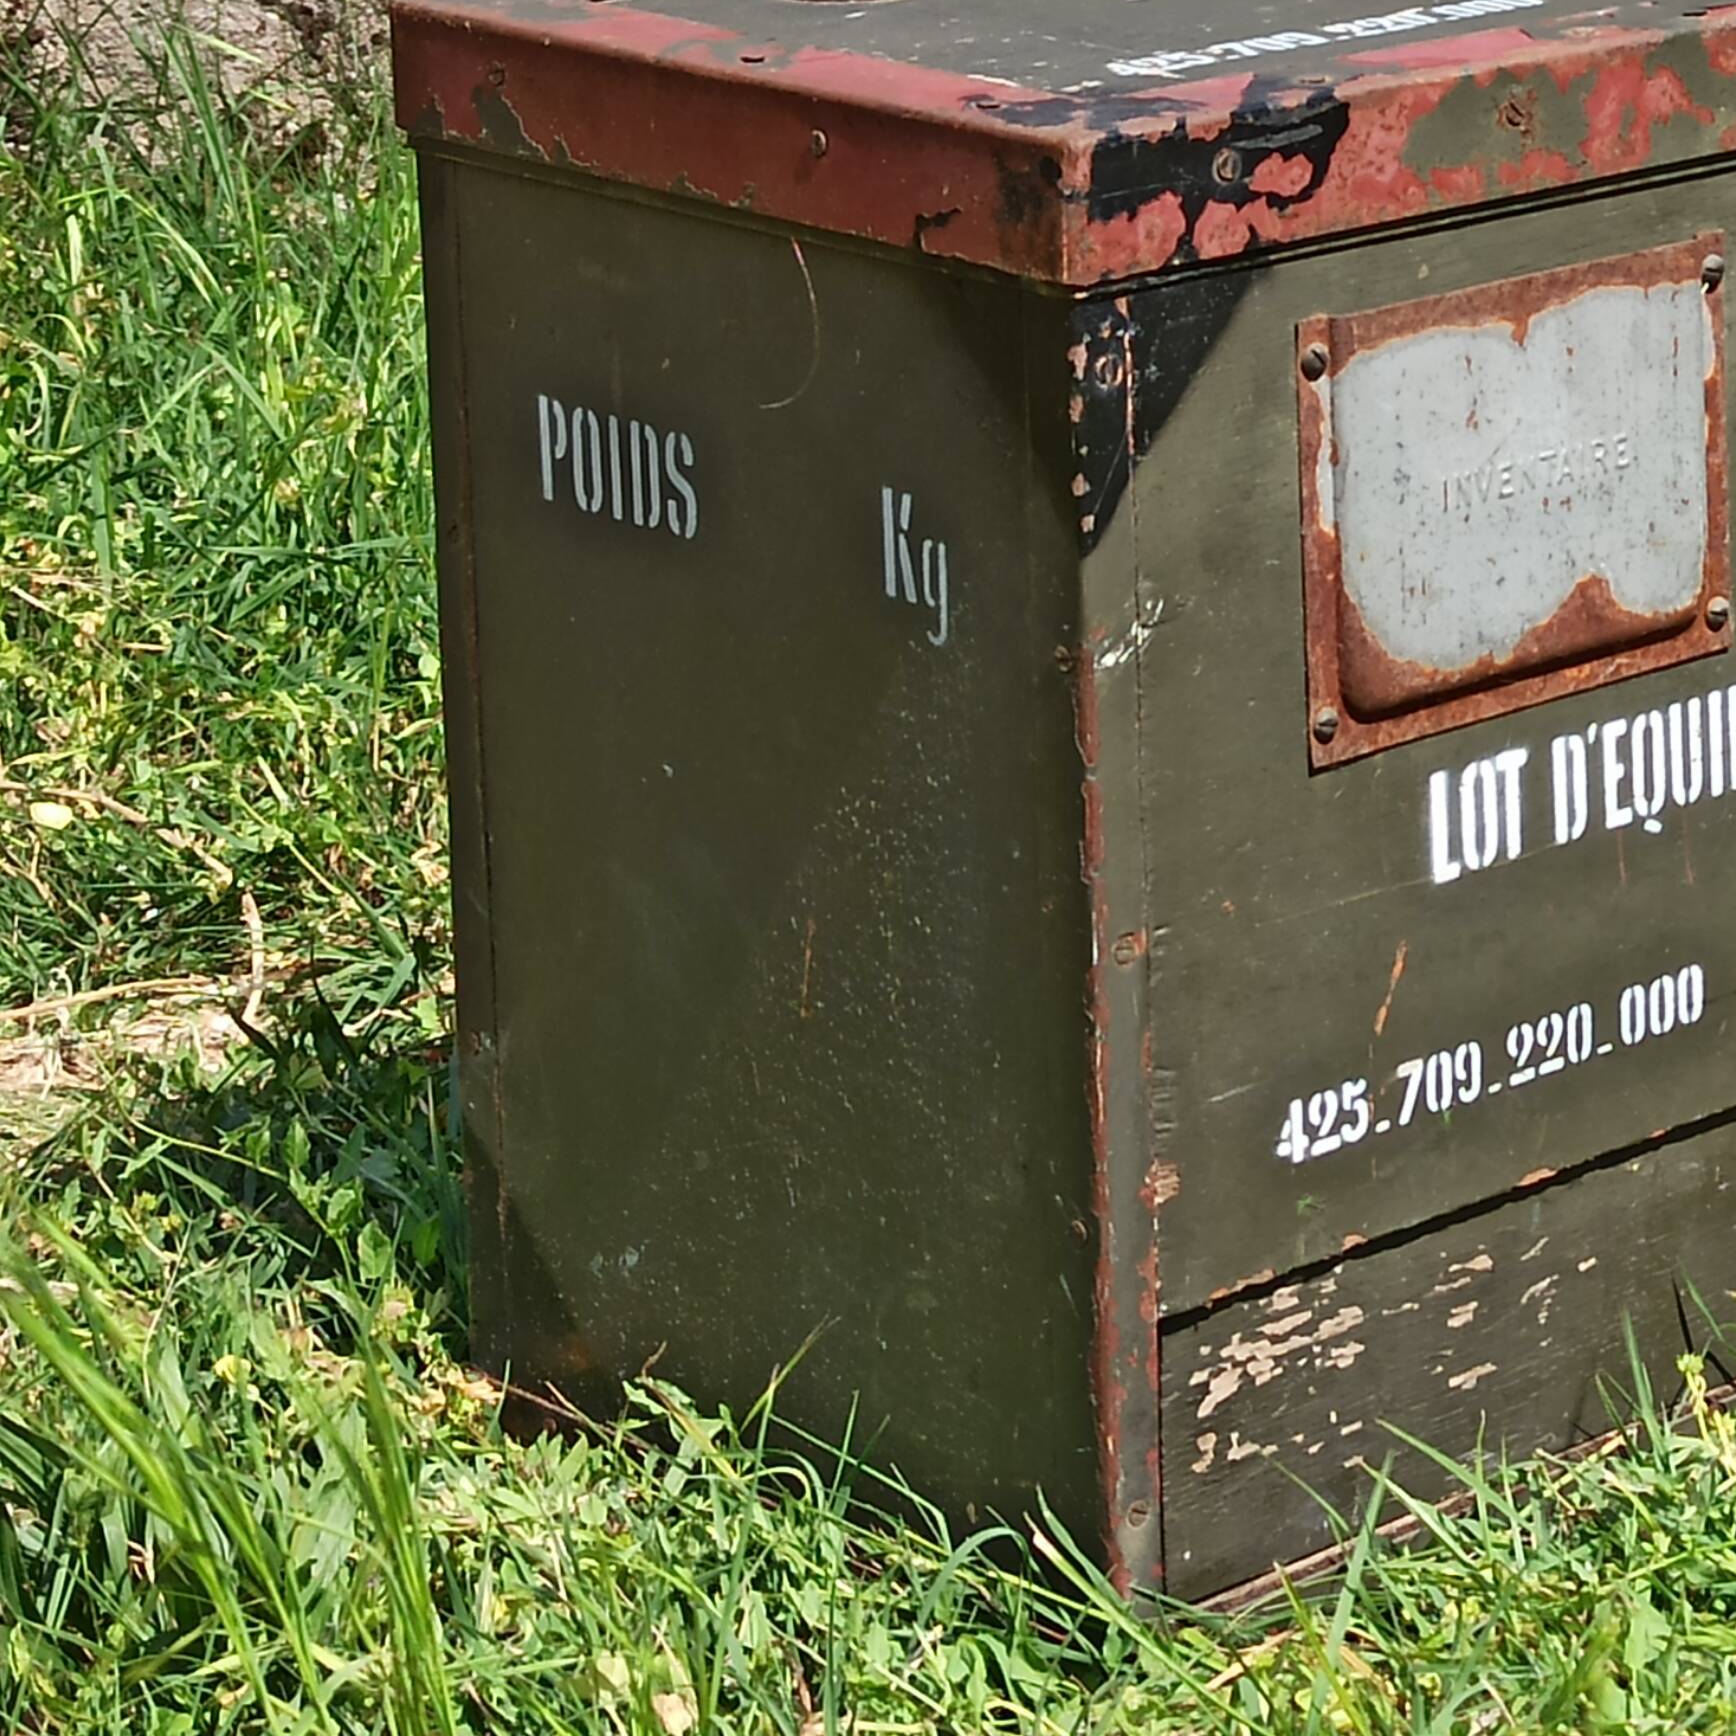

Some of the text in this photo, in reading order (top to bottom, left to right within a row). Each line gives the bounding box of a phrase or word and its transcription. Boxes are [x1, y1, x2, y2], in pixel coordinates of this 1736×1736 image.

[536, 393, 698, 540] POIDS
[1439, 427, 1632, 514] INVENTAIRE
[881, 485, 949, 646] Kg
[1428, 748, 1529, 884] LOT
